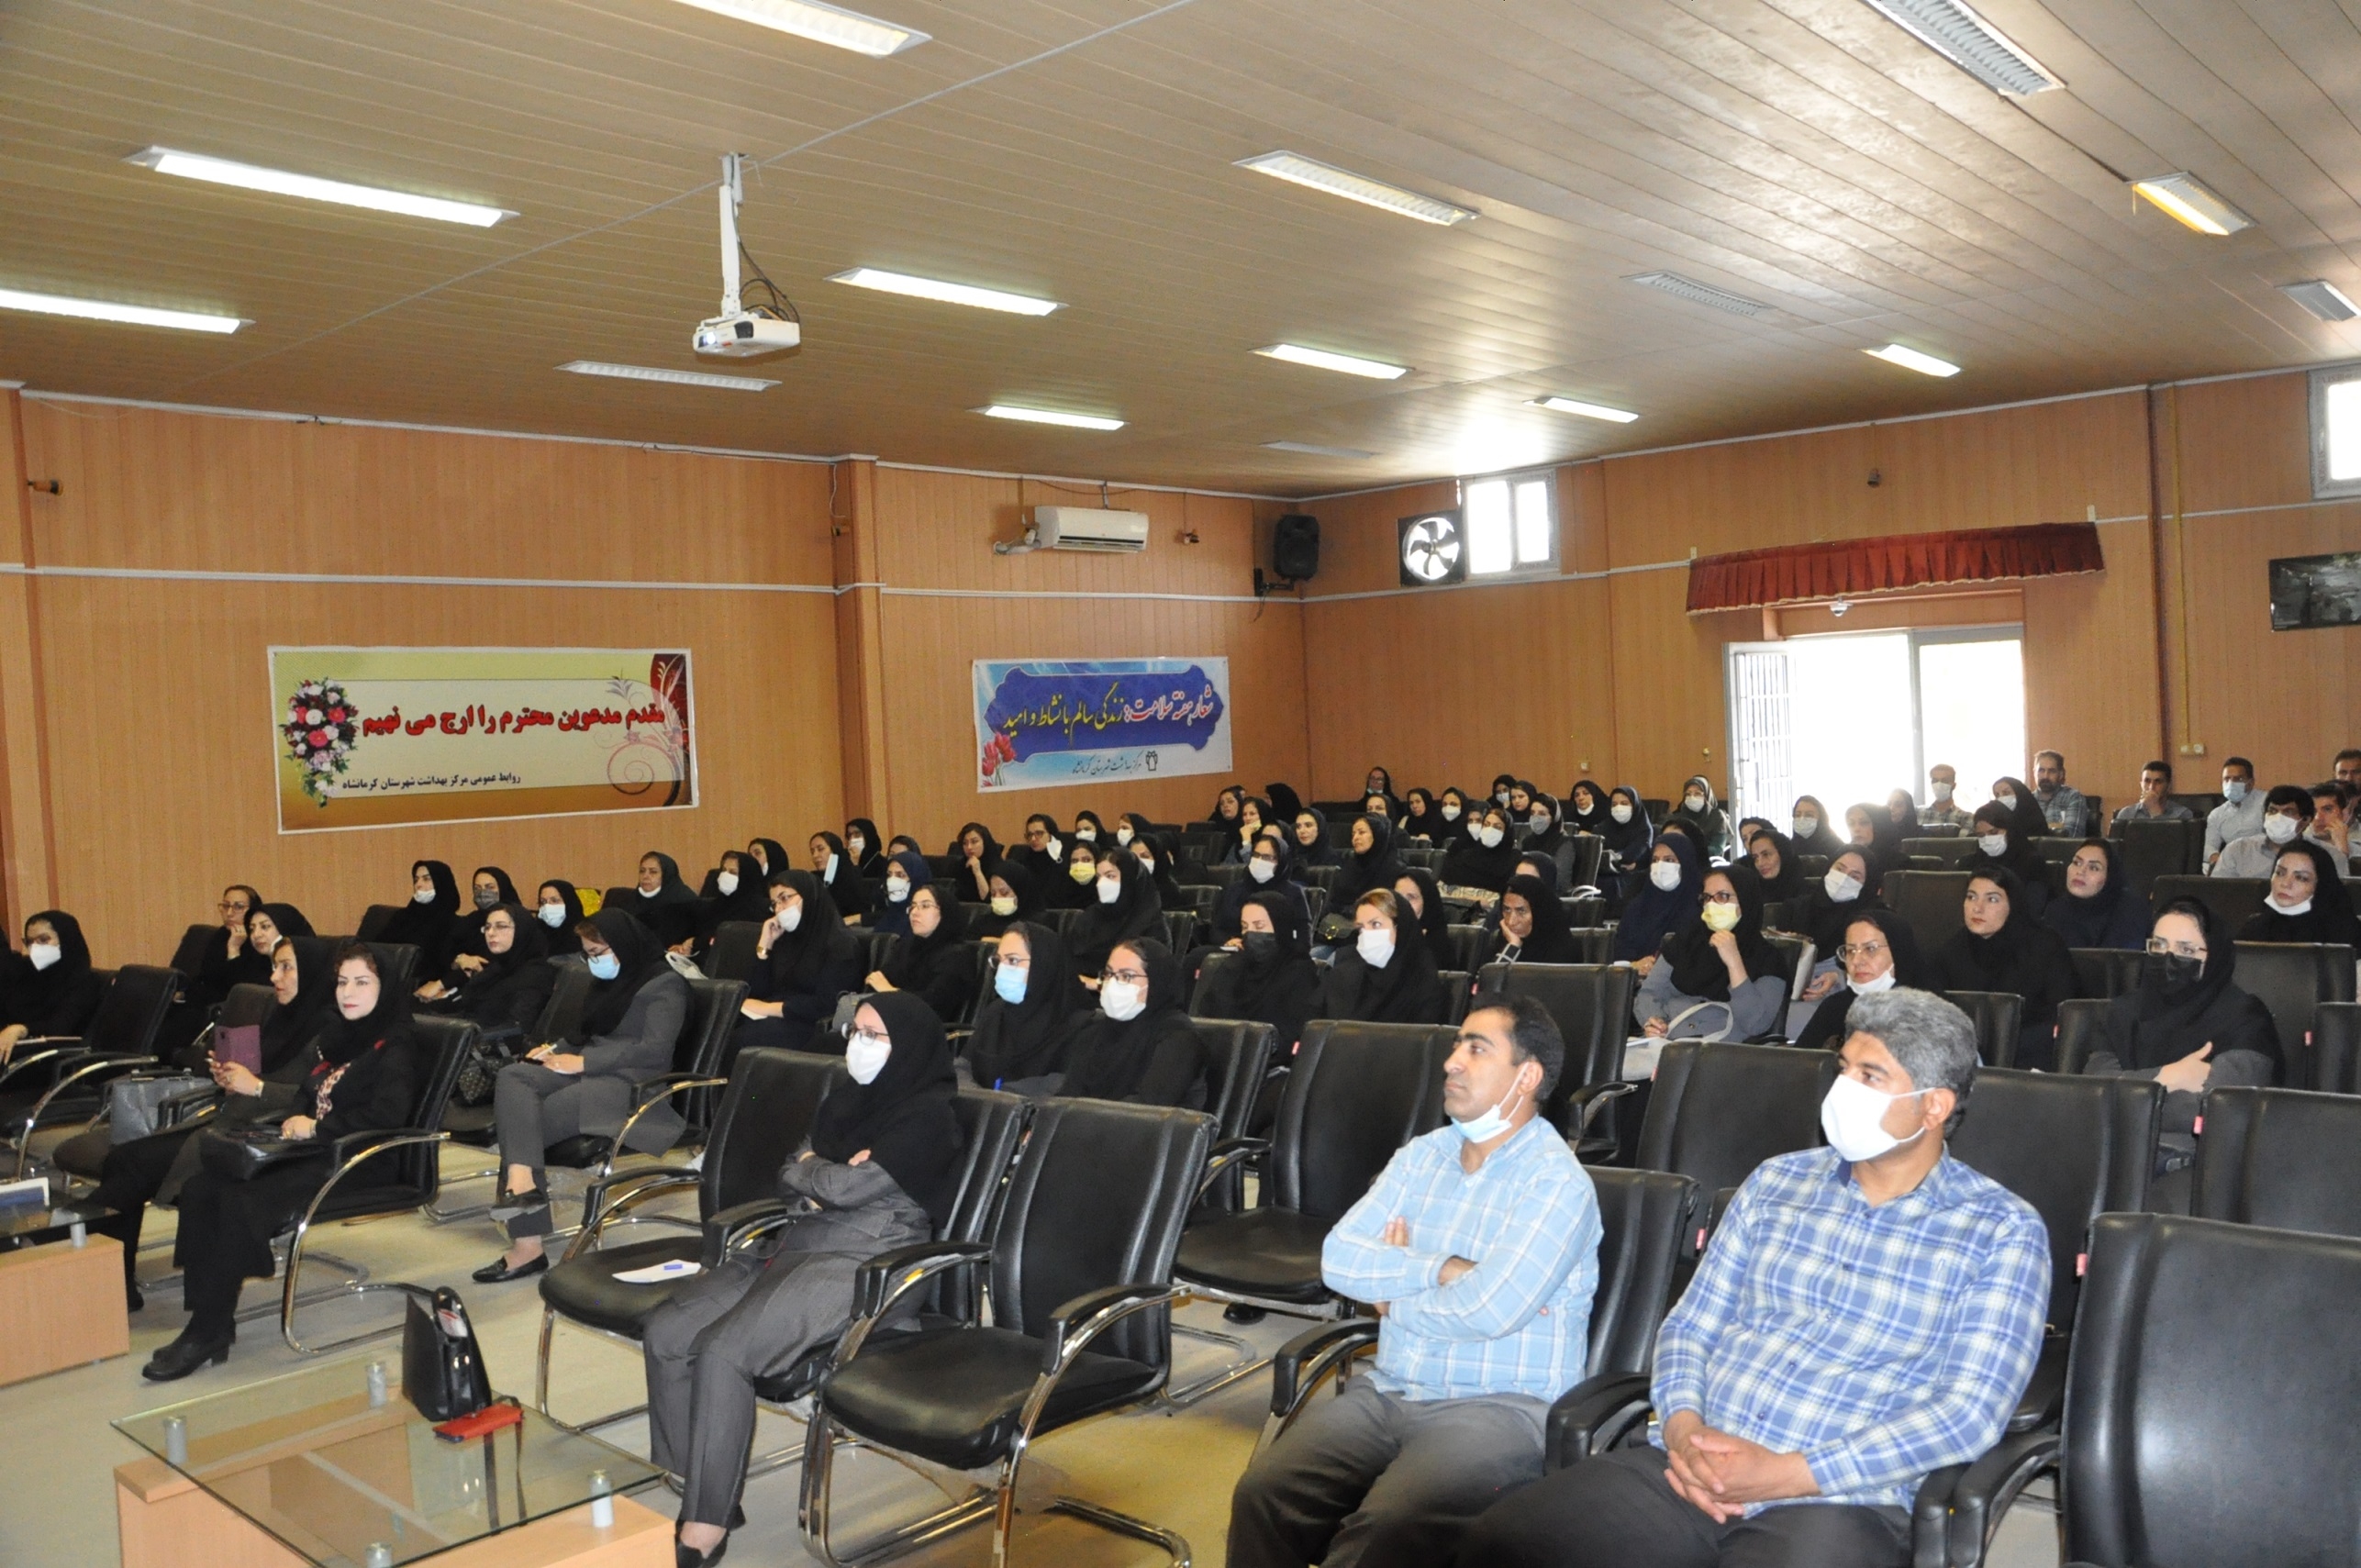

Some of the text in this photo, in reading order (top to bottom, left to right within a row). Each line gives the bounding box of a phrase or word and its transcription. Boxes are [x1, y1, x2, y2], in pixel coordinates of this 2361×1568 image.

[1037, 694, 1063, 726] نشاط
[1094, 682, 1124, 729] زندگی
[1171, 691, 1194, 727] هفته
[1192, 684, 1214, 718] شعار
[405, 714, 436, 736] می
[440, 705, 474, 735] ارج
[477, 705, 496, 734] را
[499, 707, 554, 733] محترم
[1003, 708, 1027, 738] امید
[1069, 700, 1094, 747] سالم
[342, 778, 378, 791] کرمانشاه
[381, 777, 415, 790] شهرستان
[418, 776, 448, 788] بهداشت
[451, 774, 469, 786] مرکز
[499, 772, 521, 784] روابط
